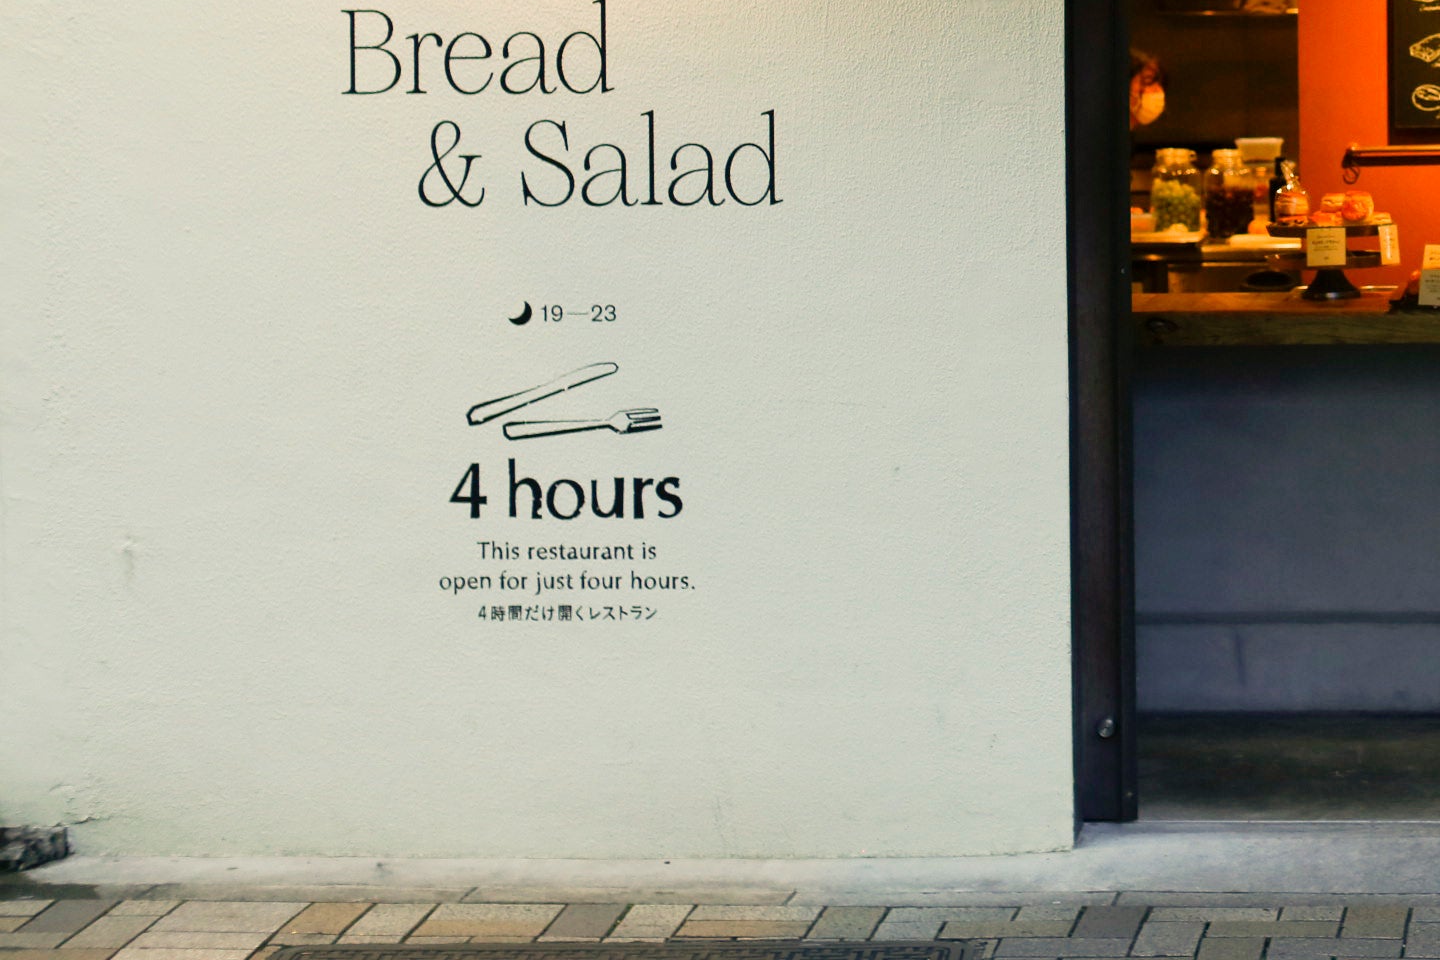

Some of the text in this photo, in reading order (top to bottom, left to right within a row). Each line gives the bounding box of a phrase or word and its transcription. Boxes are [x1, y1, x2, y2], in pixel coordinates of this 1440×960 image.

[418, 109, 783, 208] & Salad
[449, 458, 683, 520] 4 hours
[477, 541, 657, 560] This restaurant is
[439, 570, 696, 596] open for just four hours.
[477, 604, 658, 623] 4時間だけ開くレストラン
